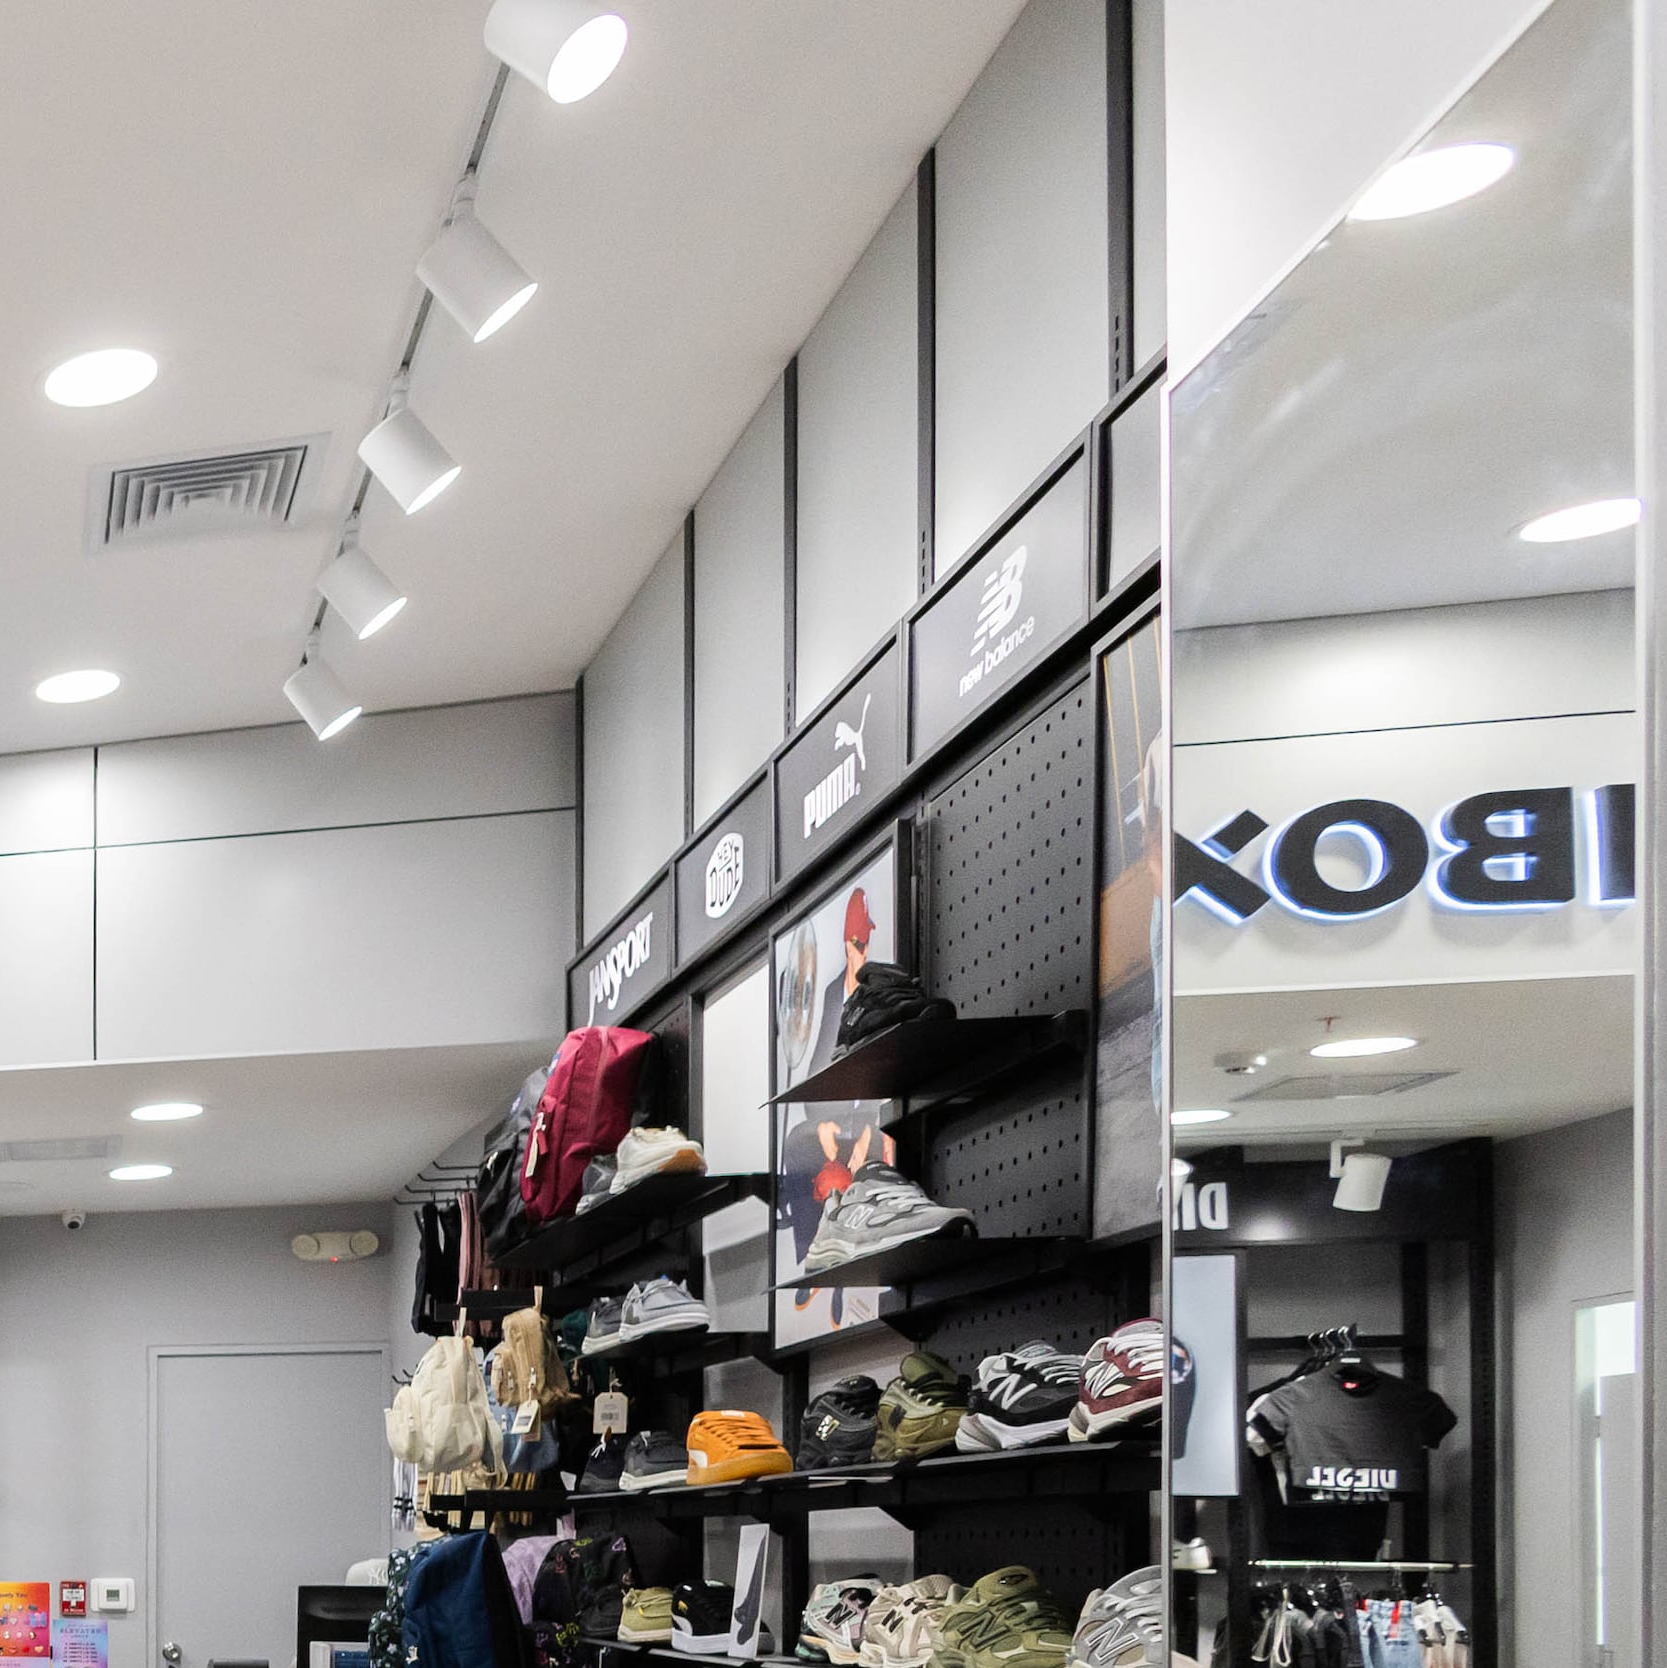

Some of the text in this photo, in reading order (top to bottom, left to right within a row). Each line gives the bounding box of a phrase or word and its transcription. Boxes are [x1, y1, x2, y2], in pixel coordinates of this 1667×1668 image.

[959, 615, 1035, 697] new balance
[803, 752, 857, 840] PUMA
[710, 846, 740, 908] DUDE
[717, 839, 735, 861] HEY
[587, 911, 653, 1027] JANSPORT
